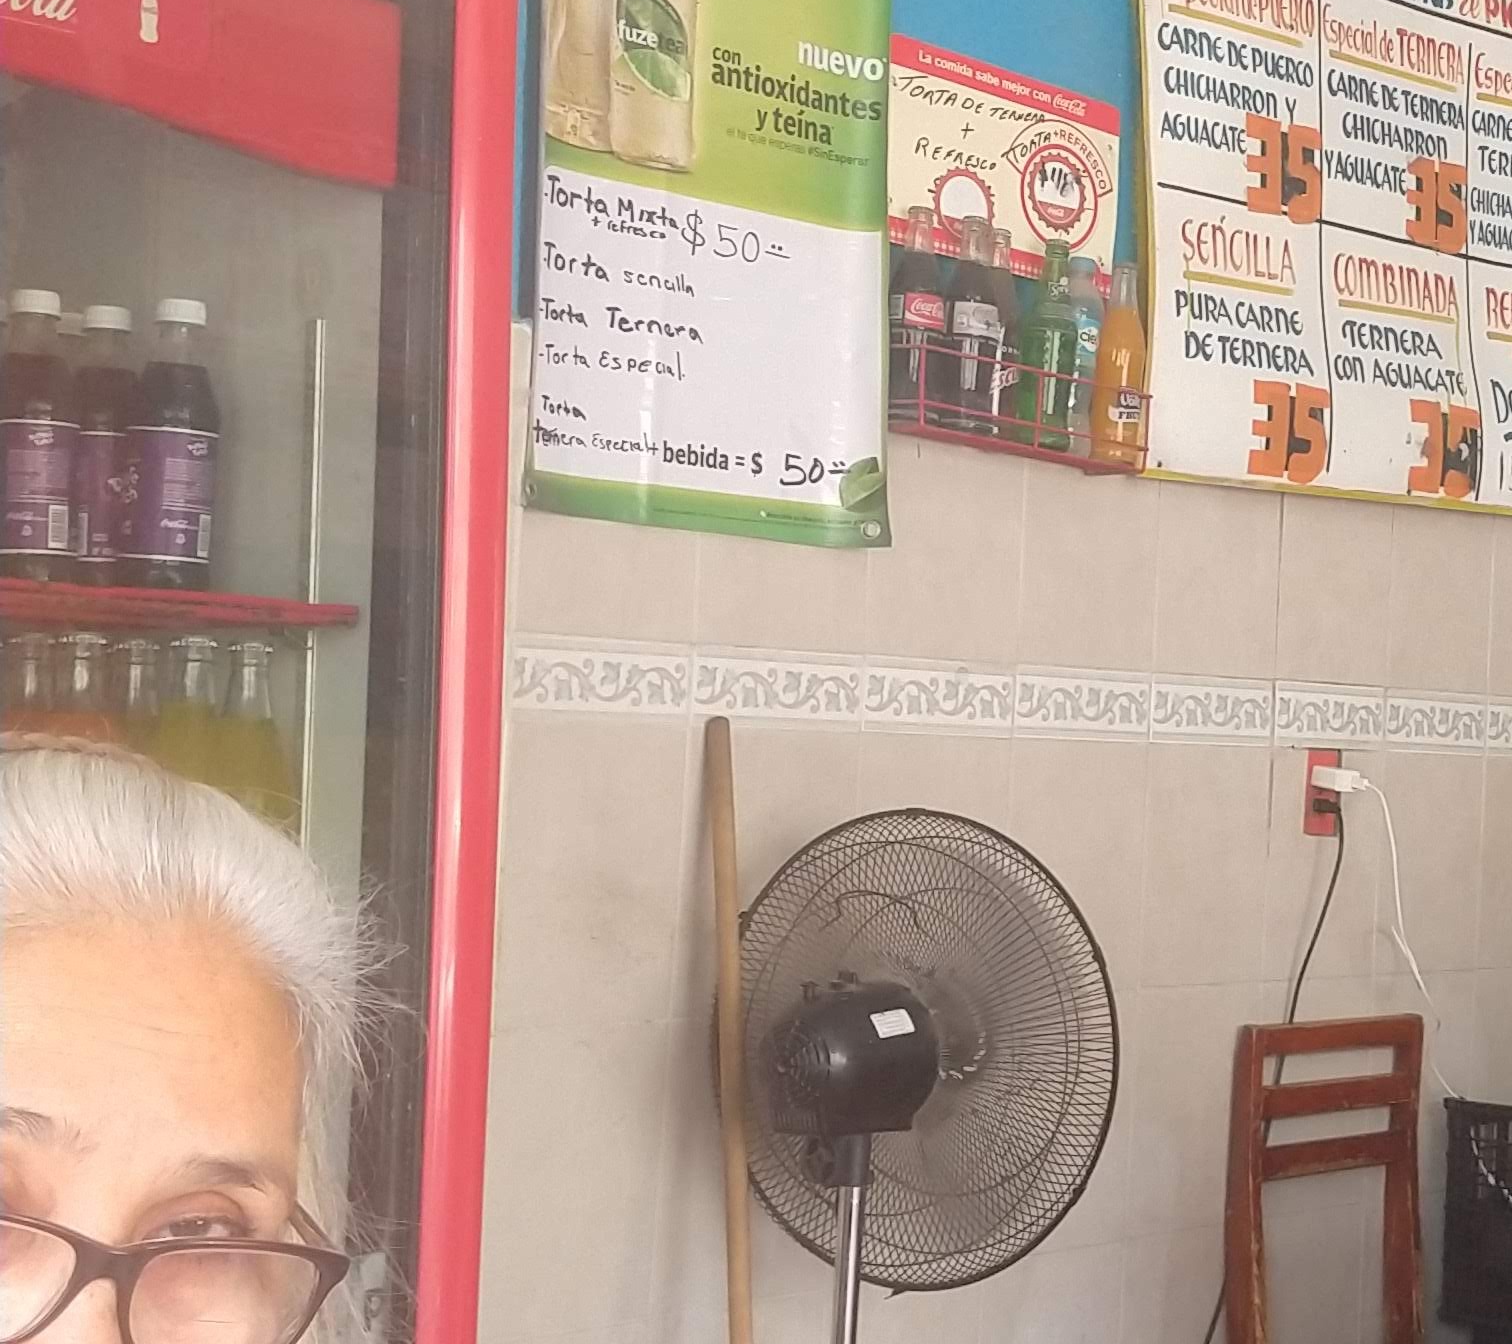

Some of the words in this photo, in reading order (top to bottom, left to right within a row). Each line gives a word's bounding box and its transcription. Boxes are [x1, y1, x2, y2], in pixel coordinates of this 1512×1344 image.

[712, 46, 742, 66] con
[798, 40, 884, 81] nuevo
[1157, 22, 1224, 63] CARNE
[1227, 40, 1248, 70] DE
[1251, 46, 1314, 88] PUERCO
[1323, 3, 1377, 60] Especial
[1379, 29, 1394, 64] de
[1396, 27, 1465, 85] TERNERA
[711, 63, 882, 121] antioxidantes
[898, 75, 958, 107] TORTA
[961, 97, 985, 114] DE
[918, 49, 932, 65] La
[934, 56, 973, 78] comida
[975, 67, 1000, 86] sabe
[1002, 78, 1031, 97] mejor
[1033, 89, 1051, 104] con
[1164, 66, 1277, 118] CHICHARRON
[1285, 97, 1297, 124] Y
[1327, 68, 1379, 107] CARNE
[1380, 84, 1400, 112] DE
[1401, 90, 1465, 131] TERNERA
[755, 109, 768, 132] y
[773, 107, 833, 146] teína
[1160, 111, 1248, 155] AGUACATE
[1342, 111, 1448, 160] CHICHARRON
[915, 136, 997, 171] REFRESCO
[1246, 112, 1322, 224] 35
[1406, 156, 1467, 254] 35
[1333, 253, 1460, 317] COMBINADA
[605, 306, 704, 344] Ternera
[1174, 289, 1233, 326] PURA
[1235, 301, 1304, 336] CARNE
[1184, 330, 1213, 360] DE
[1218, 335, 1315, 377] TERNERA
[1342, 320, 1443, 360] TERNERA
[1334, 354, 1365, 384] CON
[1372, 358, 1467, 397] AGUACATE
[1247, 379, 1331, 485] 35
[663, 440, 730, 472] bebida
